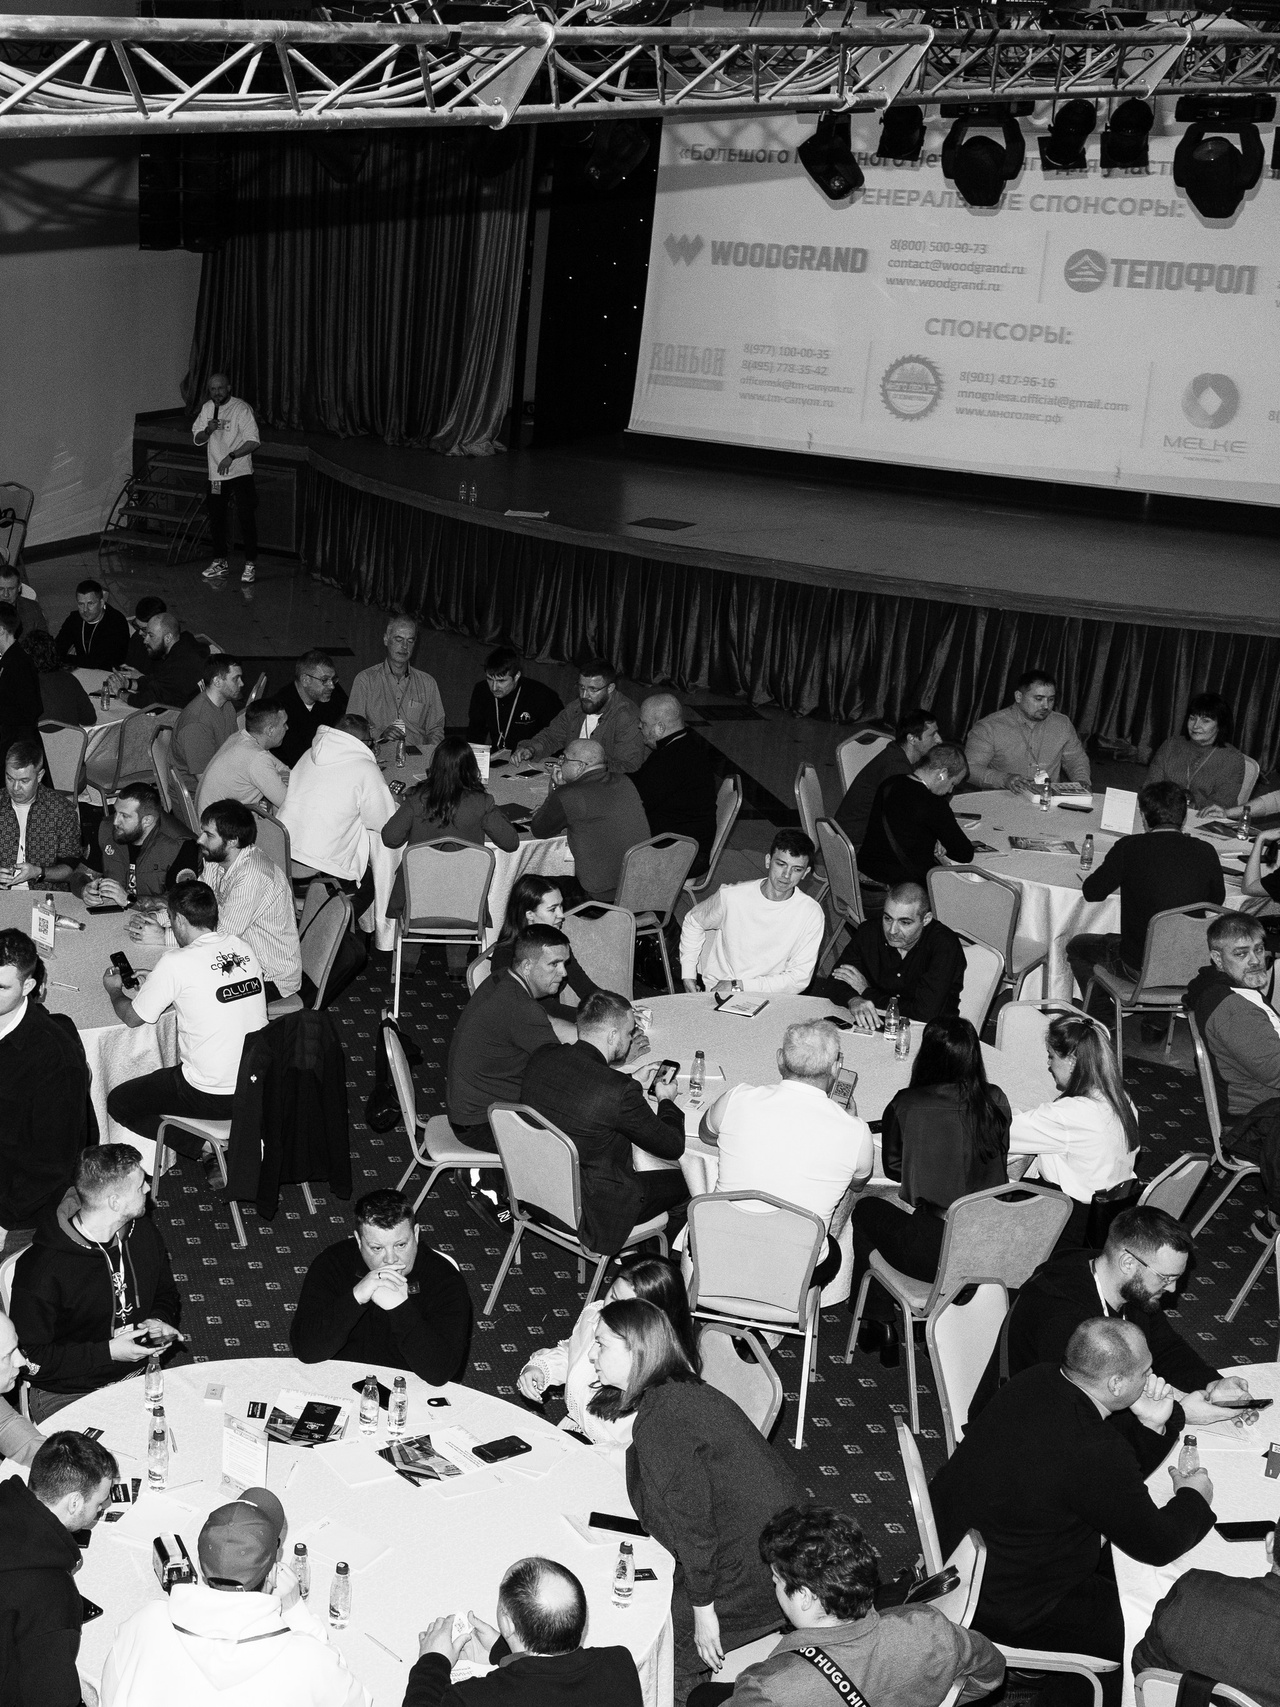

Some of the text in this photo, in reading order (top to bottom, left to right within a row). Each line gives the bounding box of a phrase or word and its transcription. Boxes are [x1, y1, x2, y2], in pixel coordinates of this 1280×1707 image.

[1029, 193, 1184, 218] СПОНСОРЫ:
[711, 240, 868, 273] WOODGRAND
[890, 239, 988, 255] 8(800) 500-90-73
[887, 257, 1026, 275] contact@woodgrand.ru
[1110, 258, 1258, 295] ТЕПОФОЛ
[885, 275, 1002, 292] www.woodgrand.ru
[924, 317, 1074, 345] СПОНСОРЫ:
[813, 1654, 851, 1693] HUGO
